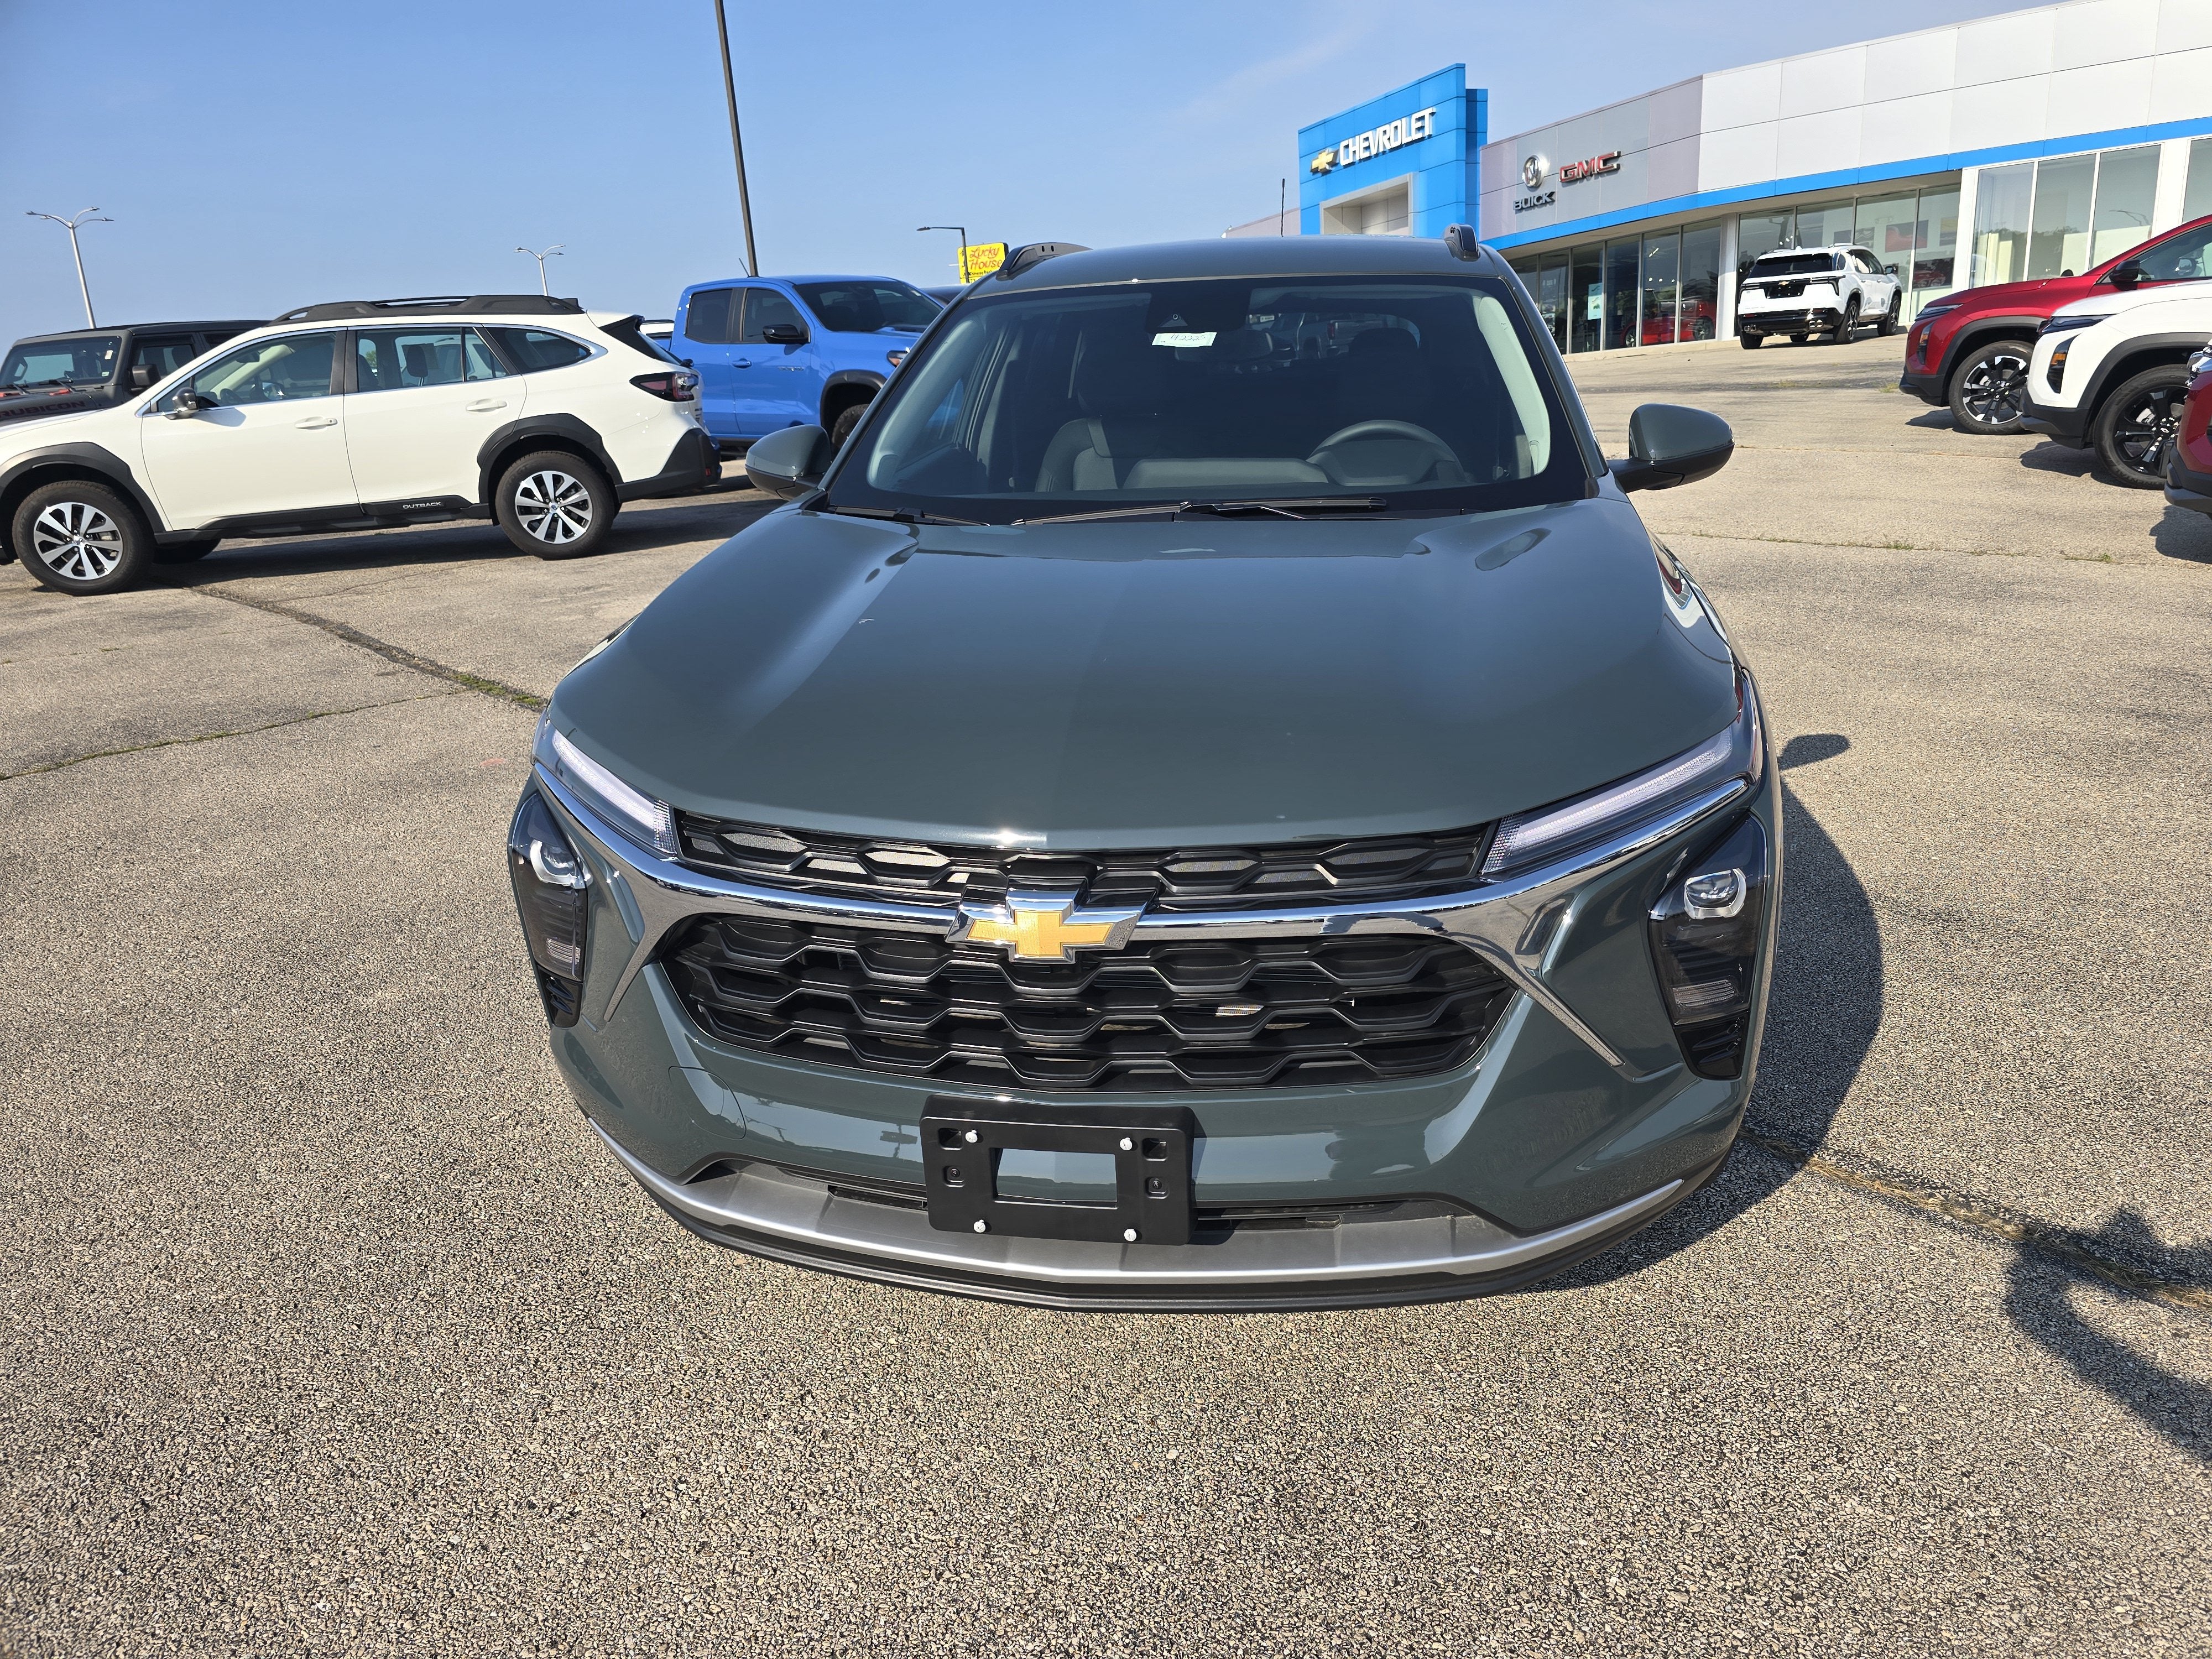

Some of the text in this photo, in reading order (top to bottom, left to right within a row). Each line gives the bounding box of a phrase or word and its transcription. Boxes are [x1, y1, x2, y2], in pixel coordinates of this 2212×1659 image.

[1340, 107, 1436, 166] CHEVROLET
[1559, 151, 1621, 182] GMC
[1513, 192, 1555, 210] BUICK
[970, 247, 1000, 259] Lucky
[969, 259, 1002, 270] House
[0, 401, 85, 418] RUBICON
